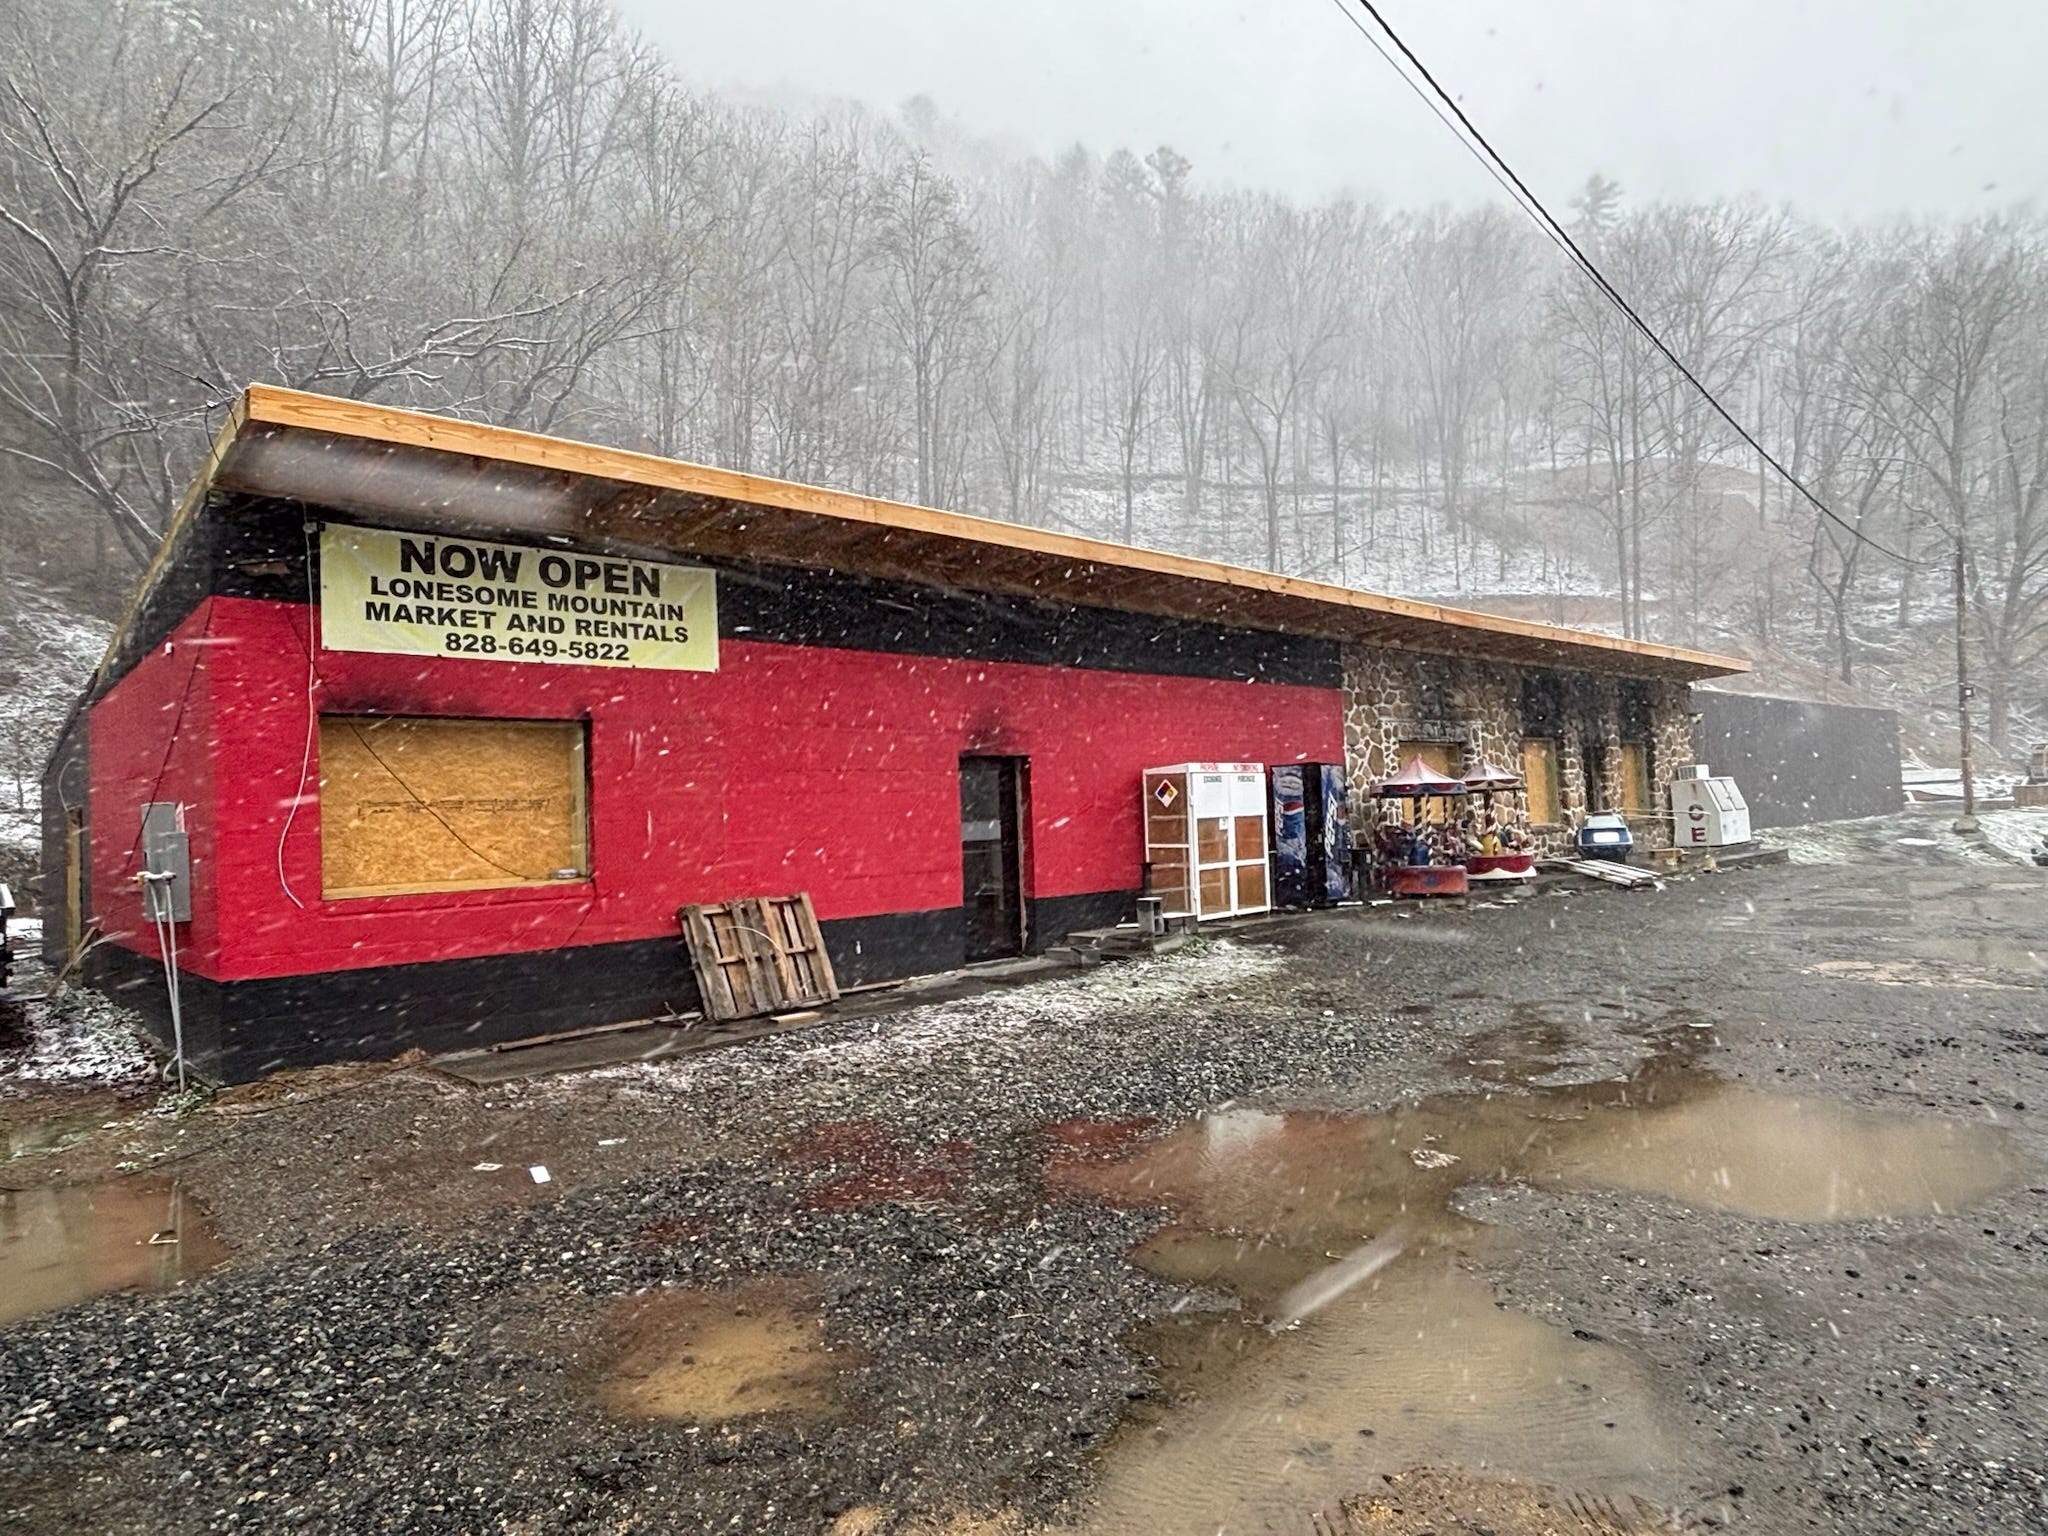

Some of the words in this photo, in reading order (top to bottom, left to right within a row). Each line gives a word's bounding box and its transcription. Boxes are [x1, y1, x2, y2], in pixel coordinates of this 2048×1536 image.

[400, 538, 522, 584] NOW
[538, 556, 661, 598] OPEN
[370, 576, 538, 609] LONESOME
[548, 593, 684, 622] MOUNTAIN
[365, 601, 497, 630] MARKET
[506, 613, 566, 635] AND
[575, 619, 689, 644] RENTALS
[445, 632, 630, 661] 828-649-5822
[1324, 790, 1338, 860] PEPSI
